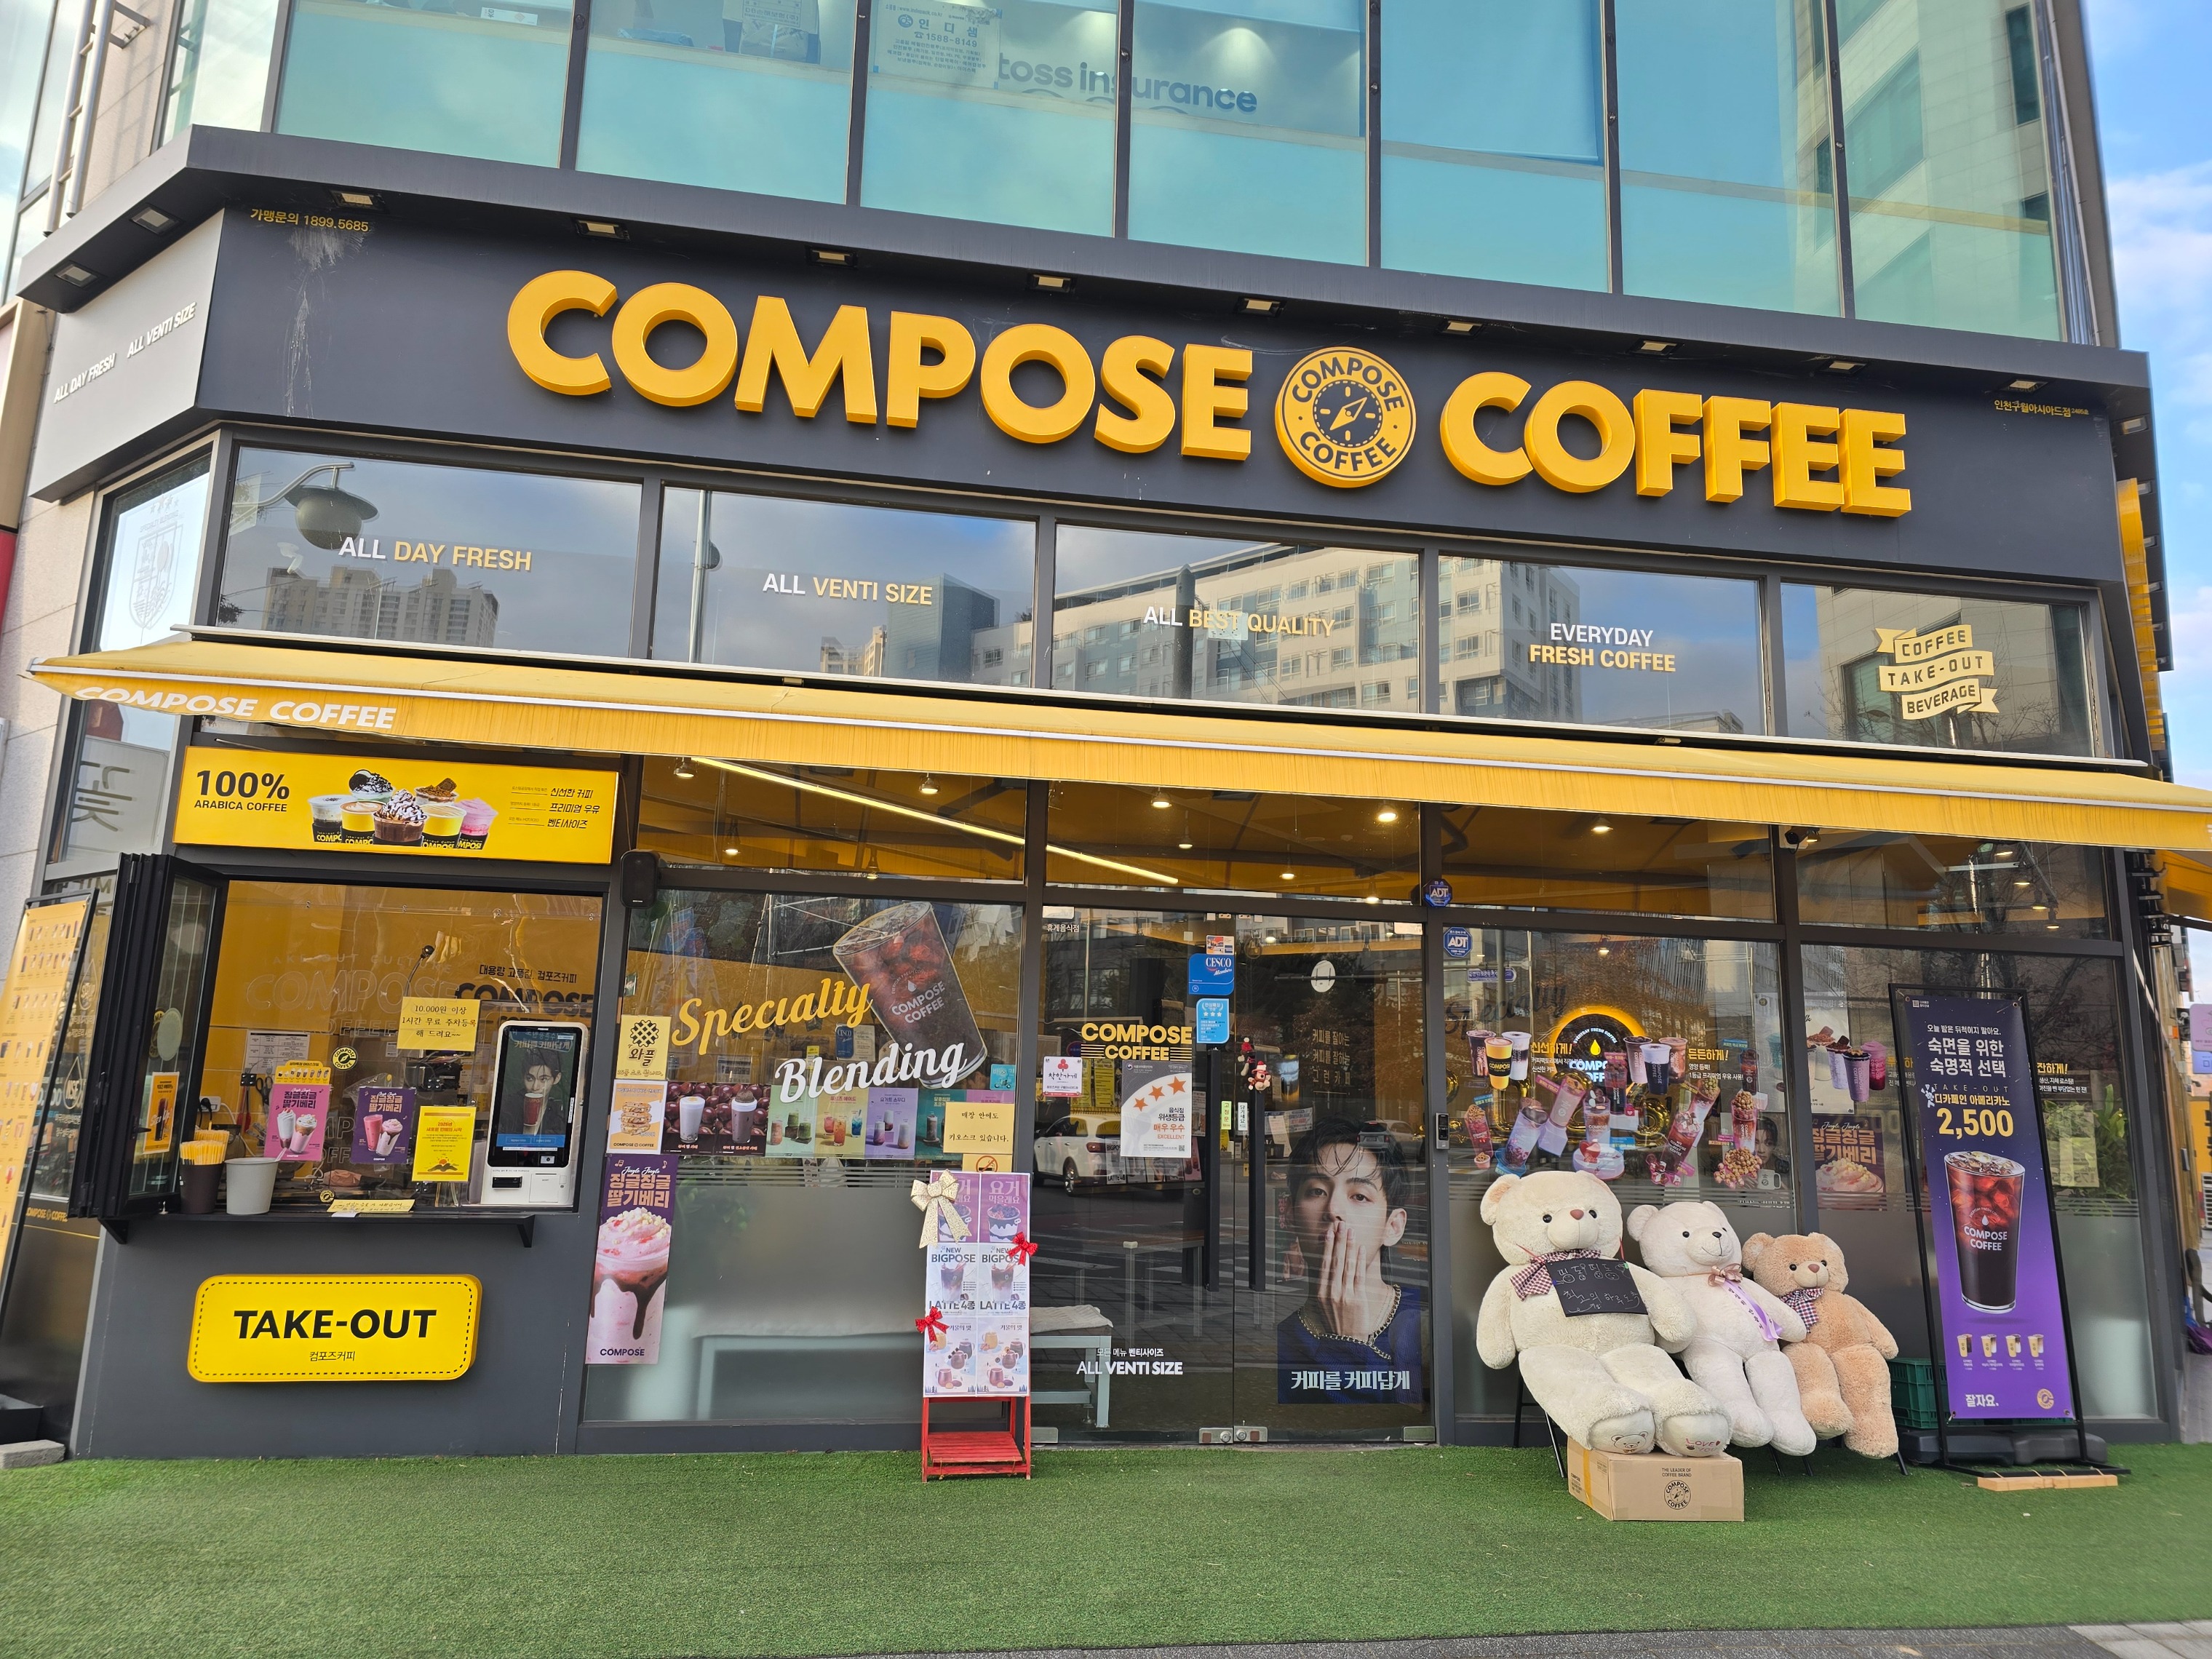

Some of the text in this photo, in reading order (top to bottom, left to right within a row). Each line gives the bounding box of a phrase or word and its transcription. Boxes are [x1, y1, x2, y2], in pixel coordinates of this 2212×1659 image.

[926, 33, 977, 47] 1588-8149
[998, 52, 1073, 88] toss
[1079, 61, 1257, 114] inurance
[251, 207, 370, 232] 가맹문의 1899.5685
[127, 301, 197, 358] ALL VENTI SIZE
[54, 352, 116, 404] ALL DAY FRESH
[1292, 357, 1405, 412] COMPOSE
[506, 269, 1912, 519] COMPOSE COFFEE
[1994, 399, 2072, 417] 인천구월아시아드점
[1300, 431, 1398, 472] COFFEE
[338, 536, 532, 572] ALL DAY FRESH
[762, 573, 933, 606] ALL VENTI SIZE
[1143, 606, 1336, 637] ALL BEST QUALITY
[1551, 623, 1653, 648] EVERYDAY
[1902, 630, 1966, 656] COFFEE
[1529, 645, 1676, 673] FRESH COFFEE
[1888, 656, 1983, 685] TAKE-OUT
[1907, 685, 1976, 713] BEVERAGE
[75, 686, 397, 729] COMPOSE COFFEE
[196, 770, 290, 800] 100%
[551, 788, 594, 799] 신선한 커피
[194, 799, 287, 813] ARABICA COFFEE
[549, 803, 600, 813] 프리미엄 우유
[547, 818, 588, 829] 벤티사이즈
[1430, 888, 1448, 898] ADT
[1046, 923, 1079, 932] 휴게음식점
[1448, 936, 1468, 948] ADT
[1206, 957, 1231, 968] CESCO
[479, 964, 577, 984] 대용량 컴포즈커피
[891, 981, 945, 1016] COMPOSE
[415, 1004, 467, 1016] 10.000원 이상
[671, 977, 873, 1056] Specialty
[904, 997, 944, 1024] COFFEE
[402, 1016, 477, 1029] 1시간 무료 주차등록
[1927, 1024, 2002, 1035] 오늘 밤은 뒤척이지 말아요.
[416, 1029, 425, 1038] 해
[1081, 1022, 1193, 1045] COMPOSE
[1312, 1028, 1350, 1046] 커피를 잘아는
[1573, 1028, 1590, 1044] EVERYDAY
[1604, 1030, 1618, 1043] COFFEE
[334, 1048, 355, 1058] COMPOSE
[1105, 1045, 1169, 1061] COFFEE
[1532, 1042, 1572, 1055] 신선하게!
[1688, 1048, 1729, 1061] 든든하게!
[1928, 1037, 2004, 1057] 숙면을 위한
[628, 1048, 656, 1067] 와플
[1312, 1049, 1331, 1065] 커피를
[774, 1039, 968, 1104] Blending
[1930, 1057, 1973, 1076] 숙명적
[1978, 1059, 2006, 1078] 선택
[1048, 1072, 1078, 1081] 착한가게
[1312, 1068, 1331, 1083] 그런
[284, 1091, 317, 1100] 징글징글
[370, 1094, 403, 1104] 징글징글
[1935, 1093, 2010, 1106] 디카페인 아메리카노
[282, 1099, 317, 1110] 딸기베리
[368, 1103, 402, 1113] 딸기베리
[961, 1111, 999, 1120] 매장 안에도
[1158, 1113, 1185, 1122] 위생등급
[1153, 1123, 1185, 1132] 매우 우수
[1936, 1107, 2014, 1140] 2,500
[949, 1133, 1009, 1142] 키오스크 있습니다.
[1813, 1128, 1876, 1146] 징글징글
[621, 1166, 661, 1177] Jingle Jingle
[609, 1172, 671, 1190] 징글징글
[989, 1180, 1021, 1196] 요거
[606, 1189, 670, 1209] 딸기베리
[988, 1195, 1021, 1204] 먹을래요
[1964, 1225, 2008, 1241] COMPOSE
[1970, 1238, 2002, 1251] COFFEE
[931, 1254, 976, 1263] BIGPOSE
[982, 1254, 1019, 1263] BIGPOS
[1563, 1289, 1602, 1304] 최고의
[1604, 1293, 1625, 1305] 하루
[929, 1300, 976, 1310] LATTE 4종
[979, 1300, 1027, 1310] LATTE 4종
[234, 1310, 437, 1339] TAKE-OUT
[309, 1350, 355, 1361] 컴포즈커피
[600, 1347, 645, 1356] COMPOSE
[1096, 1347, 1164, 1358] 모든 메뉴 벤티사이즈
[1076, 1360, 1183, 1375] ALL VENTI SIZE
[1290, 1370, 1410, 1391] 커피를 커피답게
[1965, 1393, 1999, 1408] 잘자요.
[1685, 1438, 1715, 1447] LOVE
[1666, 1481, 1690, 1494] COMPOSE
[1667, 1499, 1688, 1508] COFFEE
